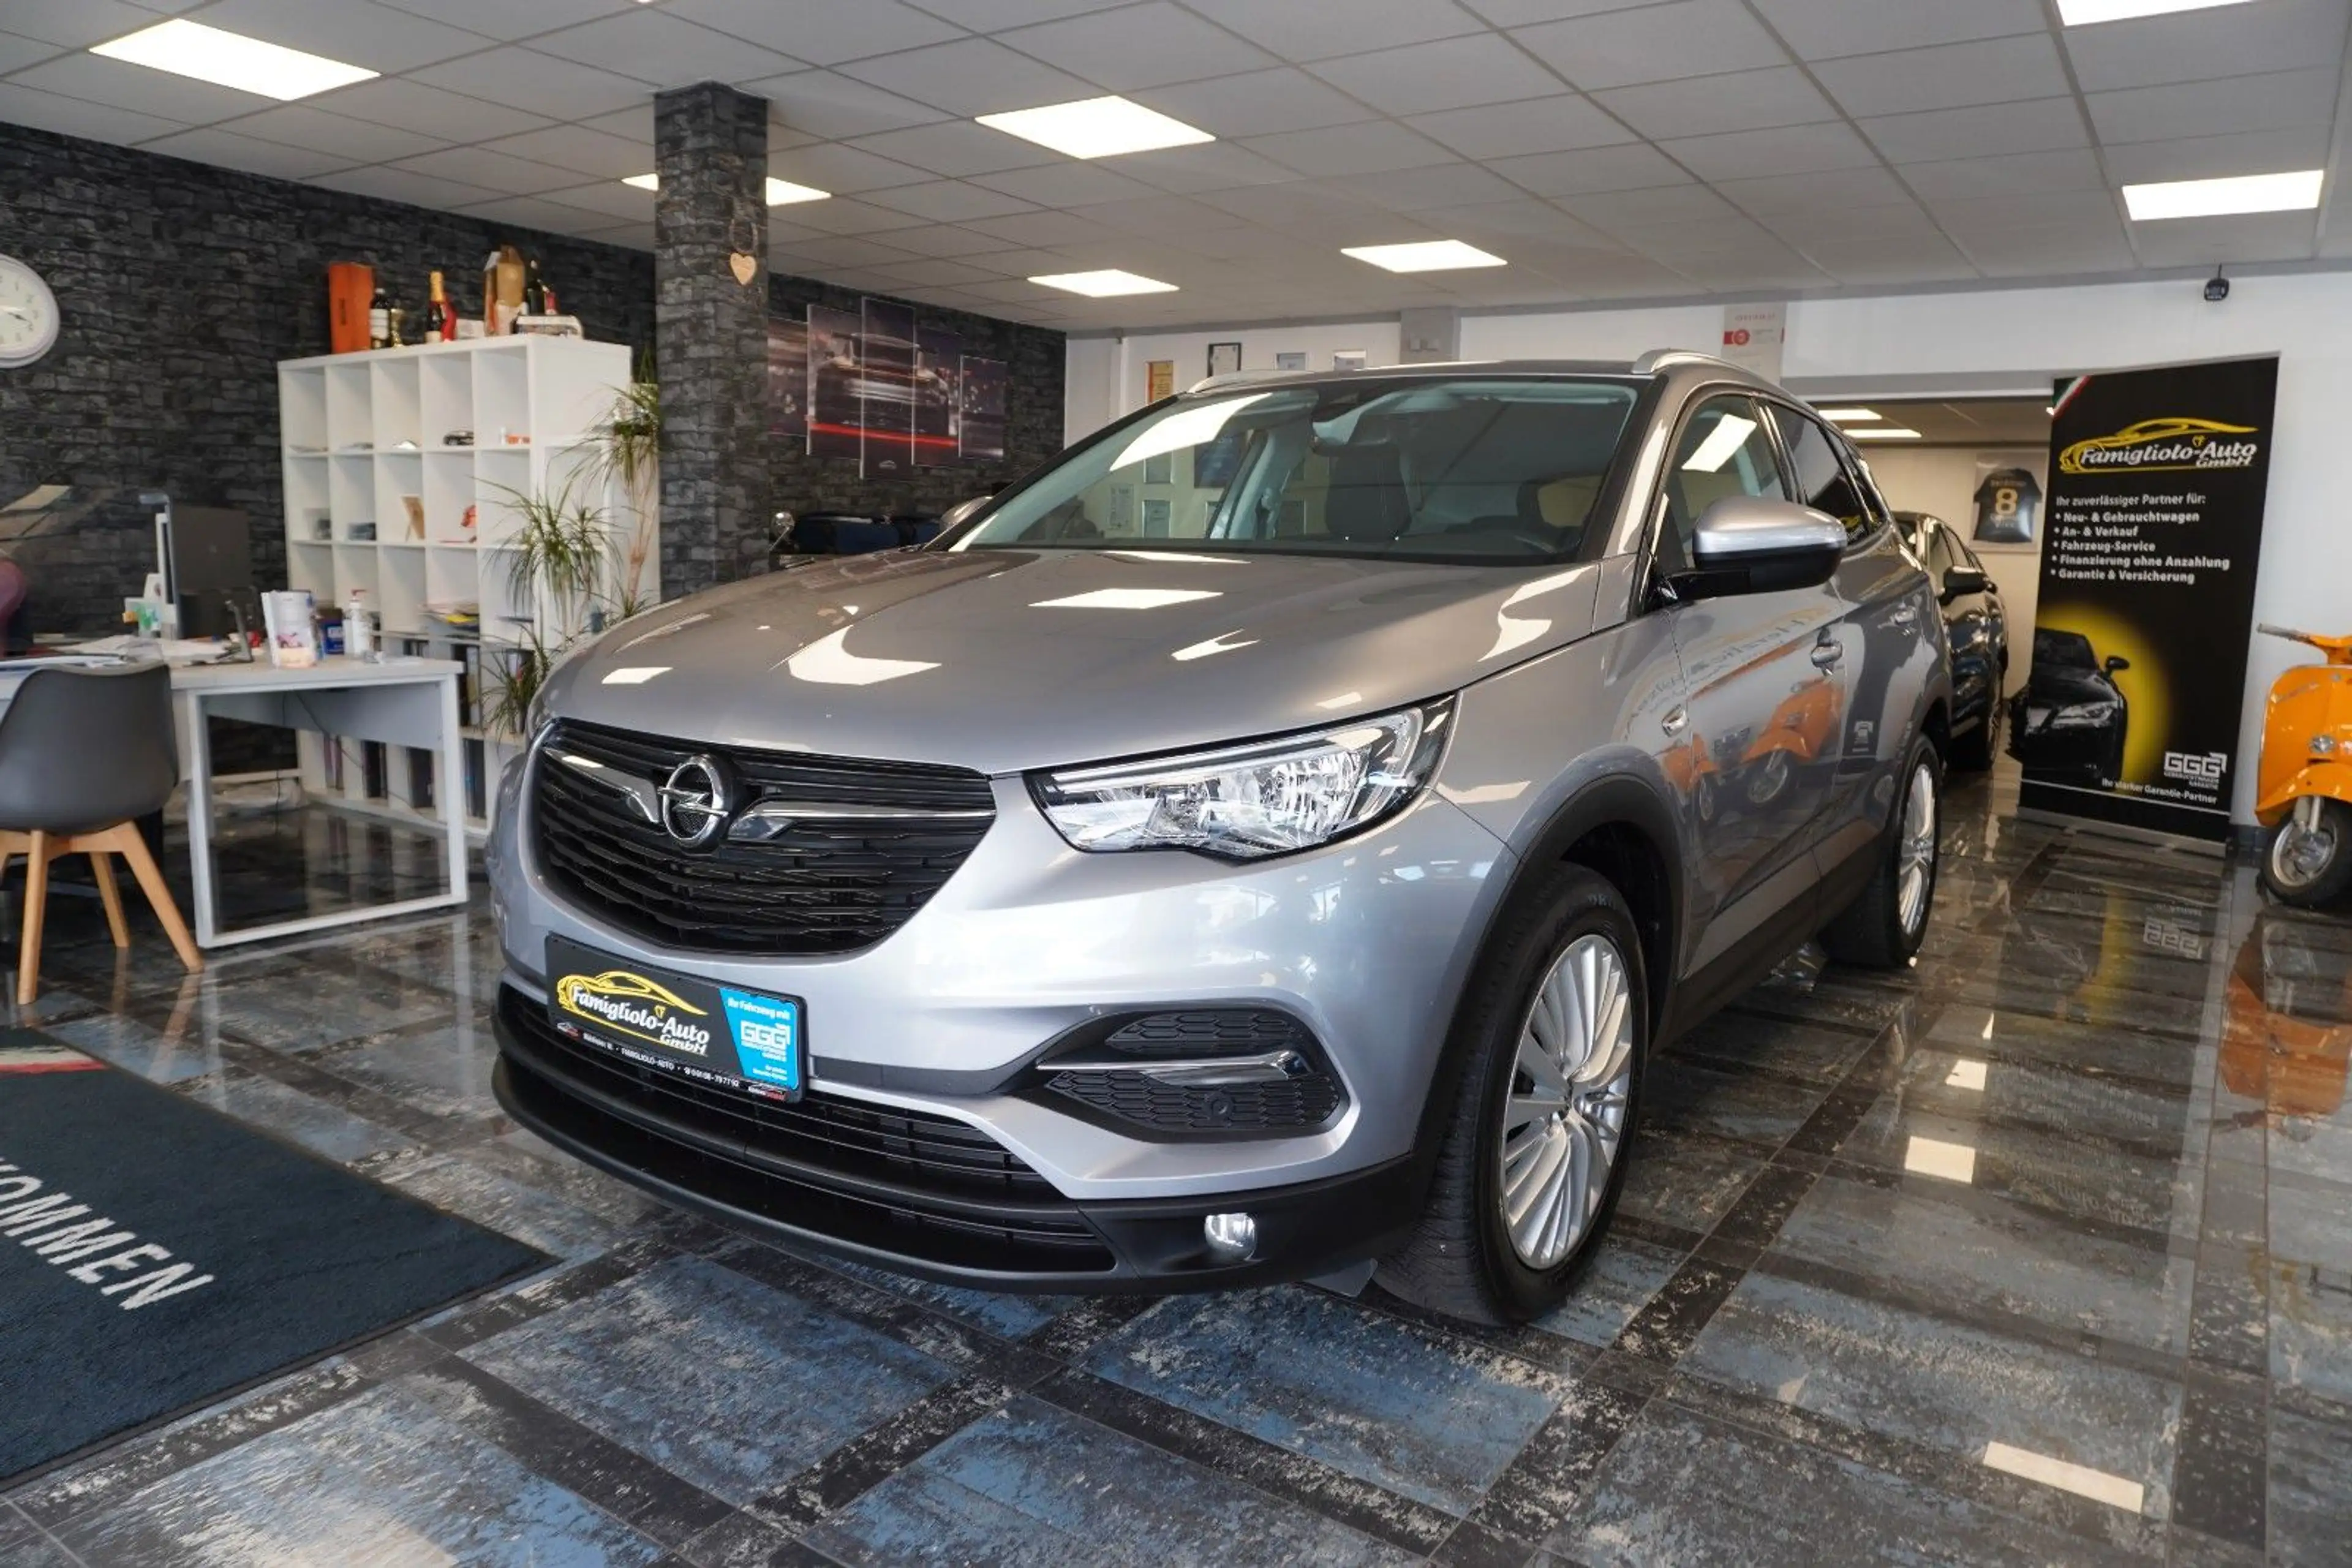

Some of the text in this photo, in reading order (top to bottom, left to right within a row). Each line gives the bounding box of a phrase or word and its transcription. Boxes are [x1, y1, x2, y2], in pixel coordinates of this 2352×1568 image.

[2082, 441, 2257, 466] Famigliolo-Auto
[2195, 458, 2252, 469] GmbH
[1996, 488, 2018, 514] 8
[2056, 492, 2206, 508] Ihr zuverlässiger Partner für:
[2063, 510, 2200, 524] Neu- & Gebrauchtwagen
[2062, 525, 2139, 537] An- & Verkauf
[2060, 540, 2156, 553] Fahrzeug-Service
[2060, 554, 2231, 571] Finanzierung ohne Anzahlung
[2058, 568, 2196, 585] Garantie & Versicherung
[2163, 751, 2228, 778] GGG
[2144, 785, 2218, 805] Garantie-Partner
[572, 984, 710, 1045] Famigliolo-Auto
[659, 1034, 709, 1057] GmbH
